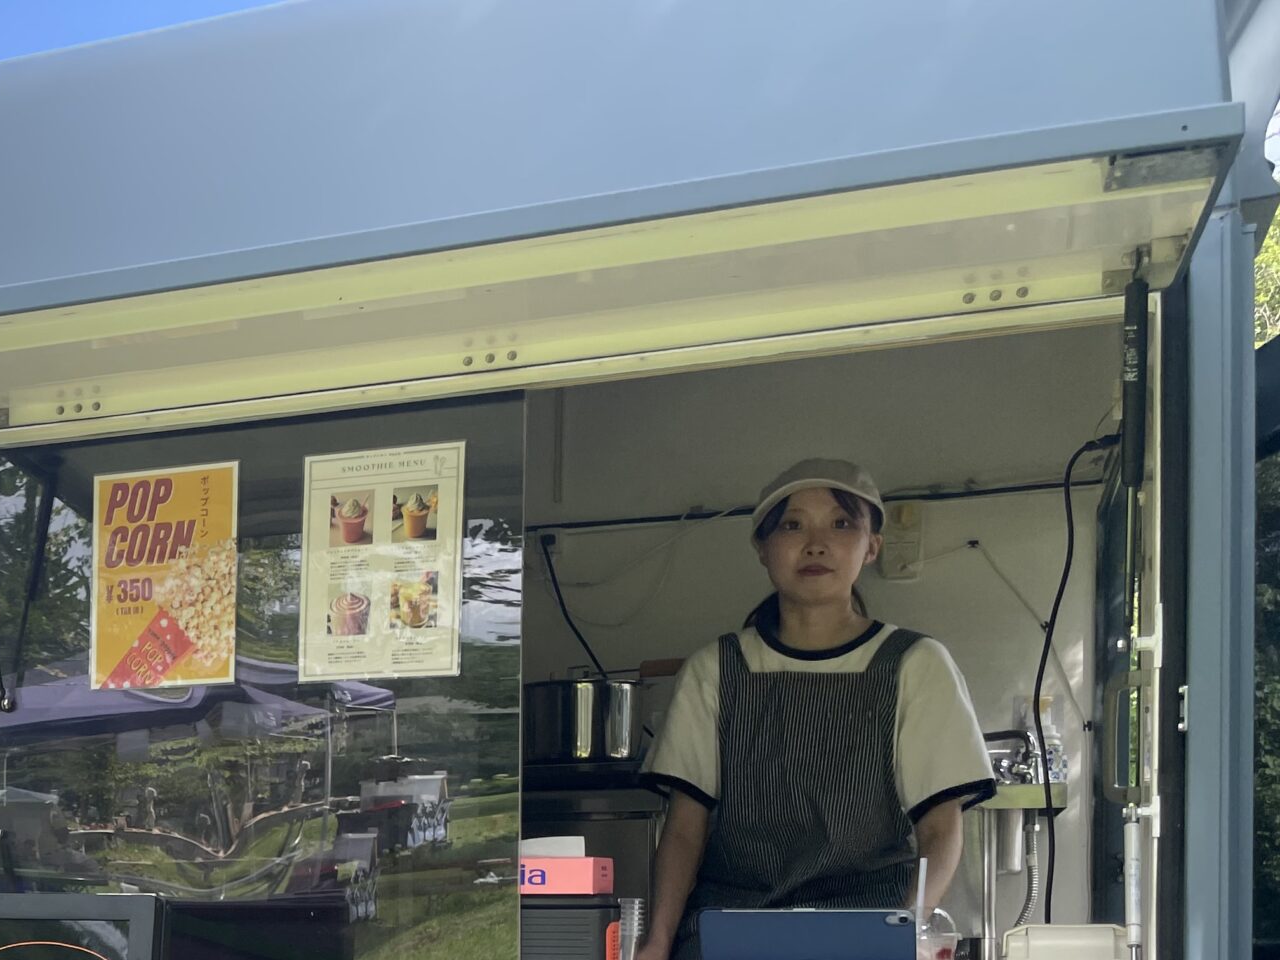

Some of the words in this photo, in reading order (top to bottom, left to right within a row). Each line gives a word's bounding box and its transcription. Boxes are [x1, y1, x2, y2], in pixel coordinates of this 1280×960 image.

[341, 461, 394, 473] SMOOTHIE
[398, 458, 426, 469] MENU
[104, 478, 173, 525] POP
[200, 475, 209, 538] ポップコーン
[104, 519, 197, 569] CORN
